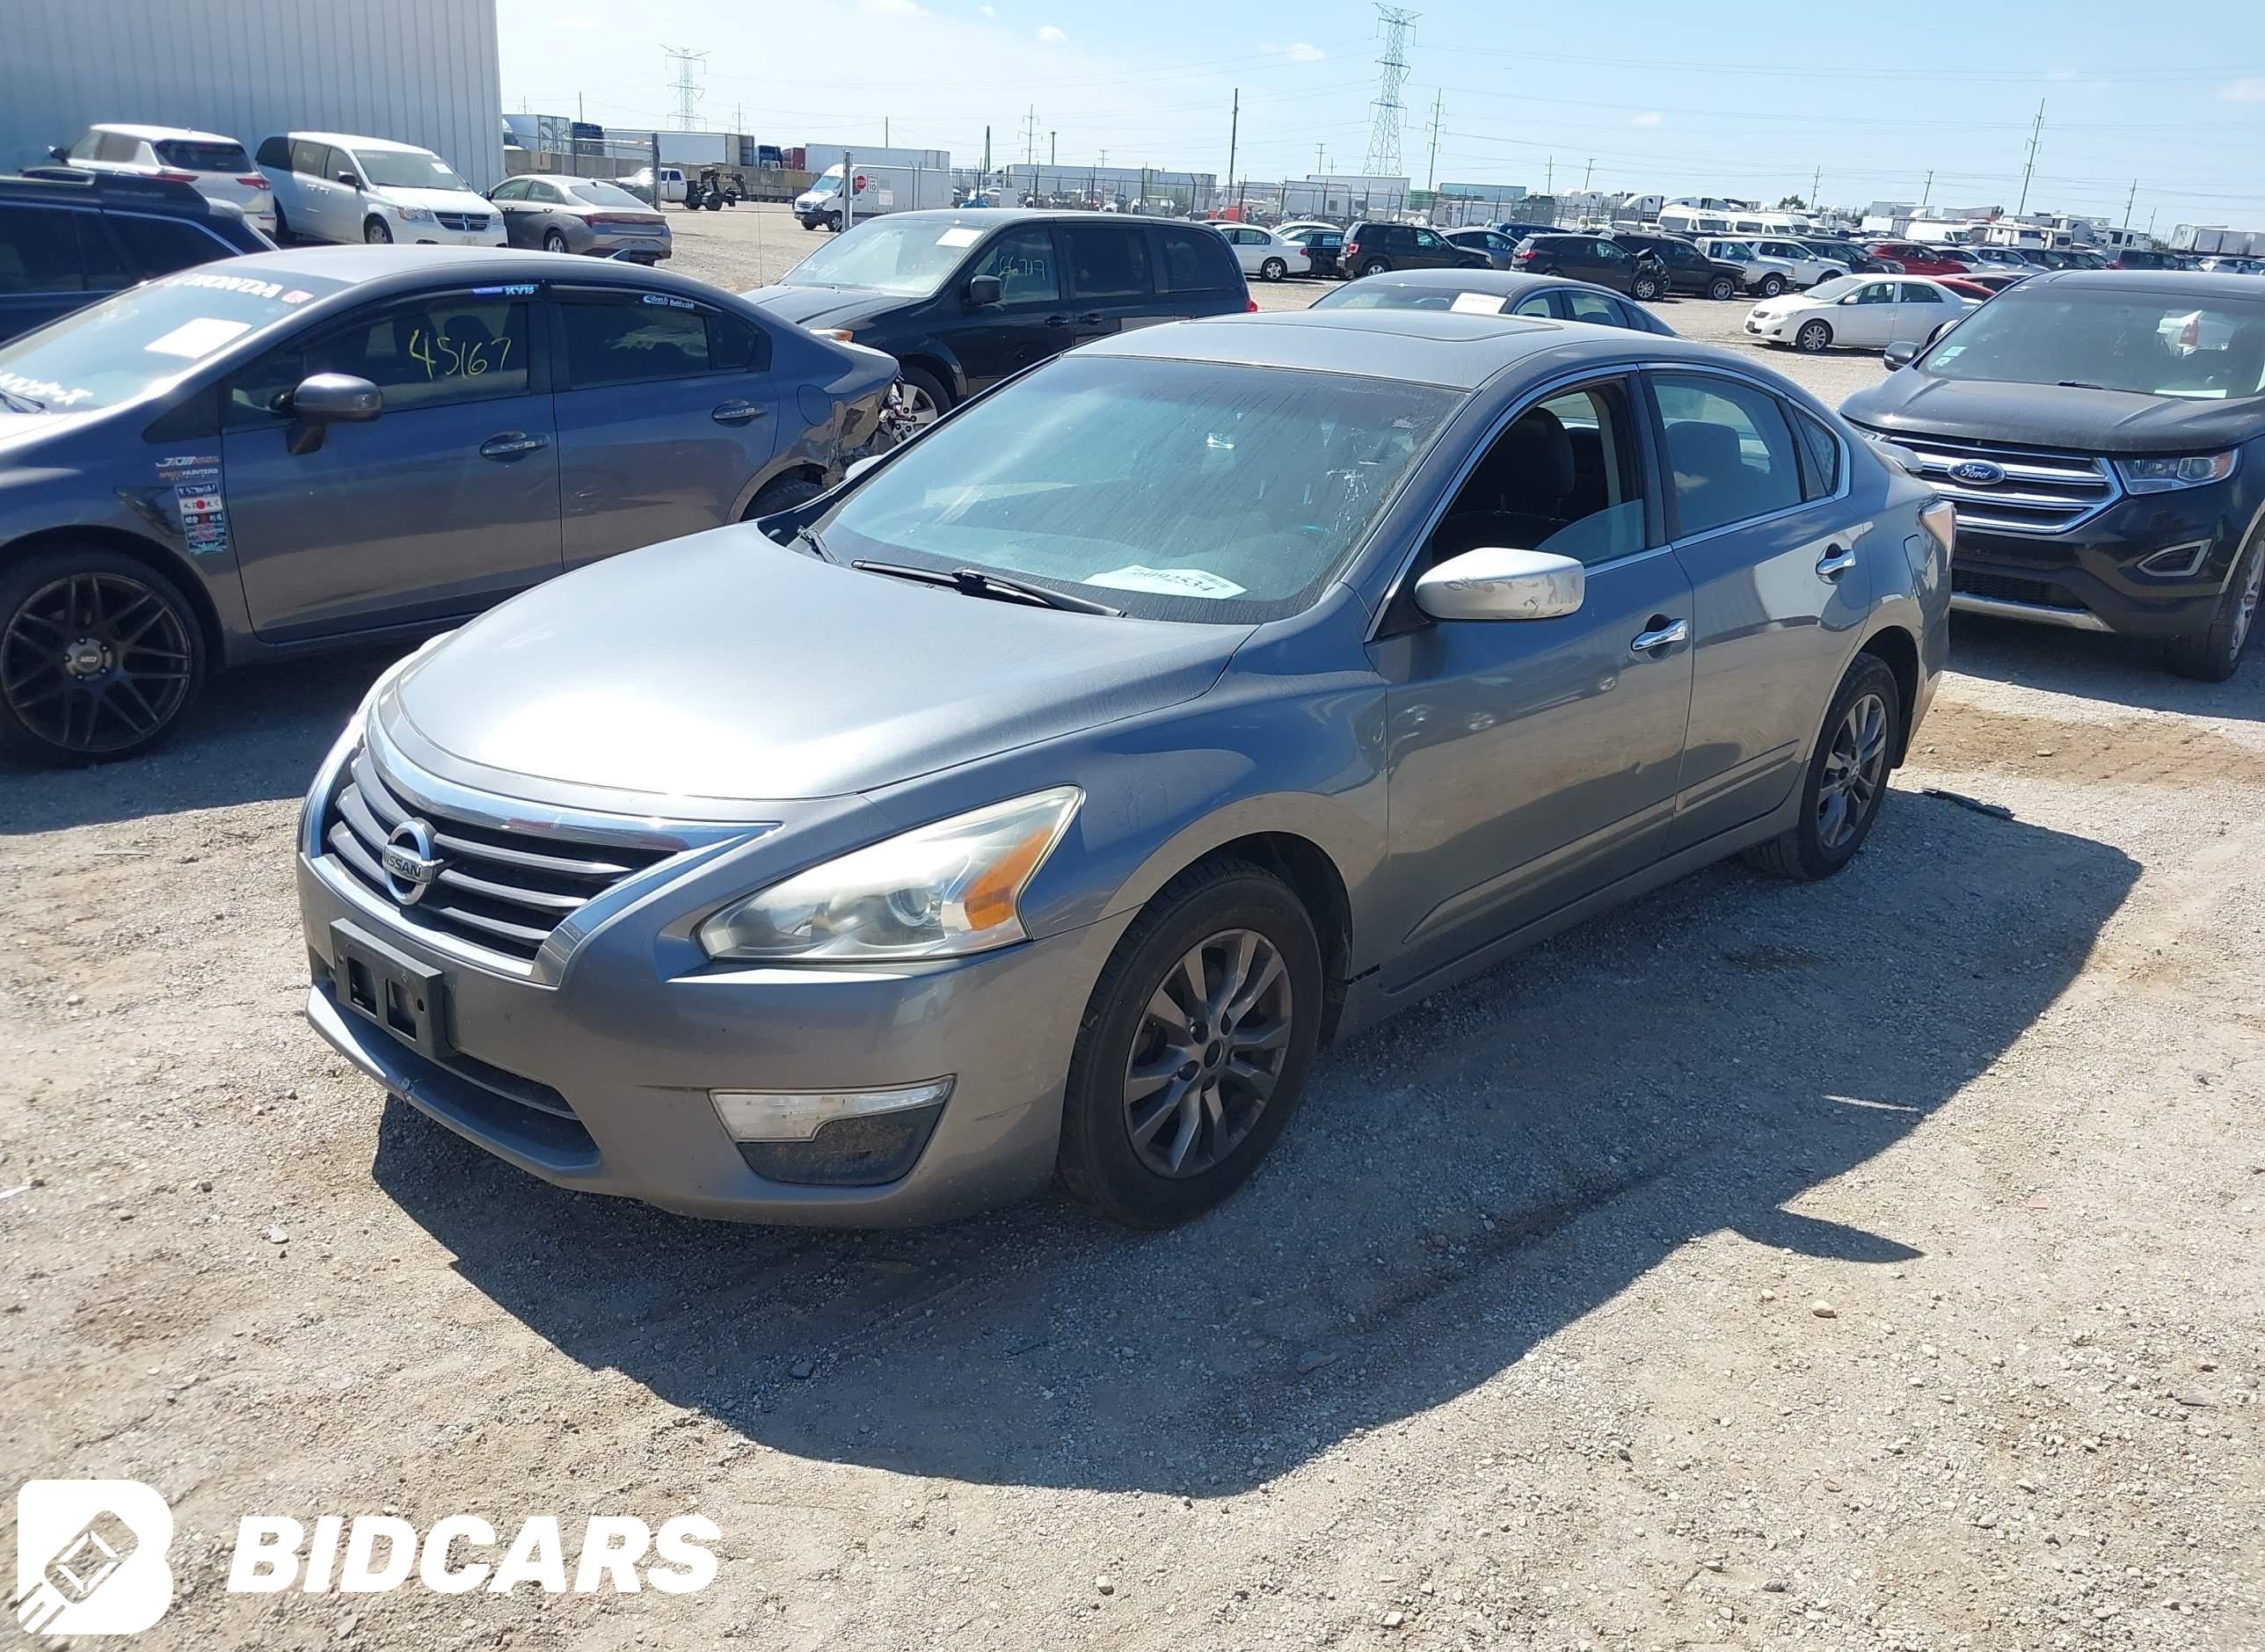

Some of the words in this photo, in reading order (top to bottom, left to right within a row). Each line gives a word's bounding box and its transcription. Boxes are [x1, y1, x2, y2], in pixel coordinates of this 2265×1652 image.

[869, 183, 877, 192] 10
[409, 328, 512, 380] 45167
[1959, 463, 1992, 480] Ford
[383, 848, 422, 877] NISSAN
